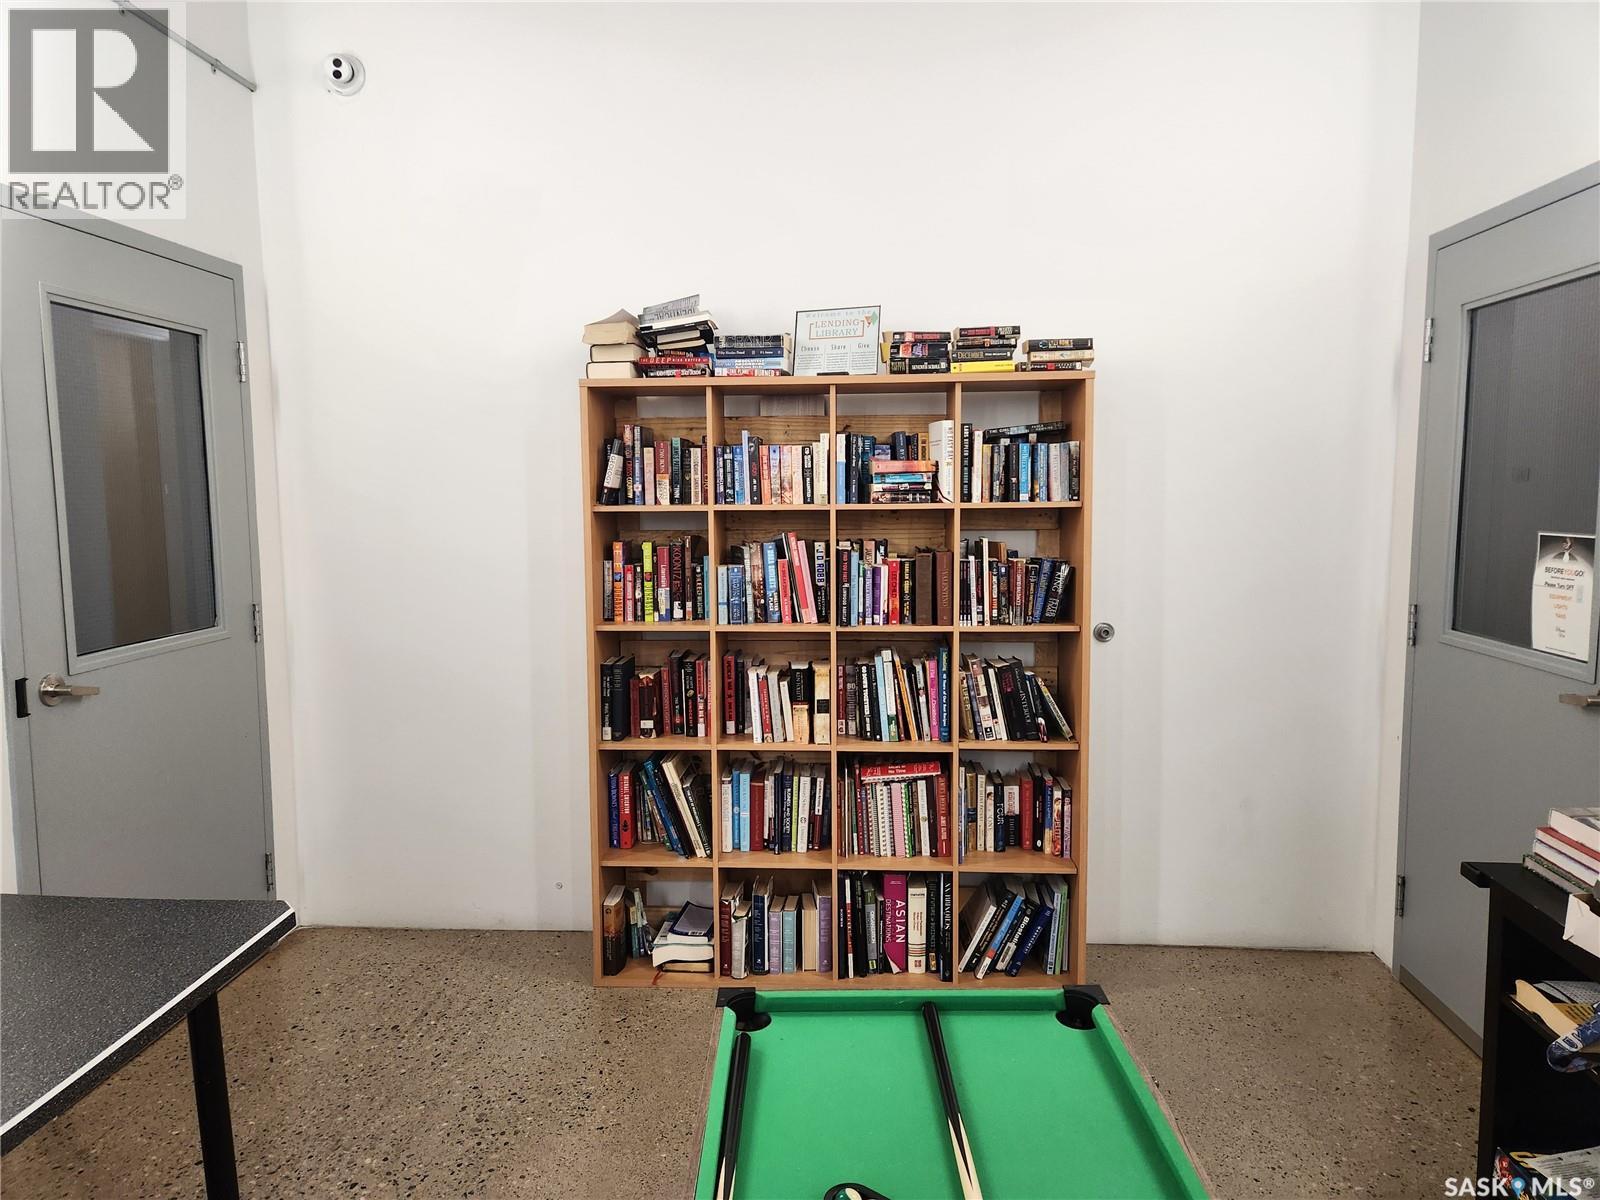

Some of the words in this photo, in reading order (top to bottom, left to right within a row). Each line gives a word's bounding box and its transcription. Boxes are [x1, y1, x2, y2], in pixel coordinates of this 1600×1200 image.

[815, 319, 860, 329] LENDING
[815, 328, 858, 337] LIBRARY
[606, 456, 616, 485] GEOLOGY
[672, 547, 681, 579] KOONTZ
[1051, 572, 1061, 592] KING
[996, 803, 1004, 825] FOUR
[896, 900, 906, 943] ASIAN
